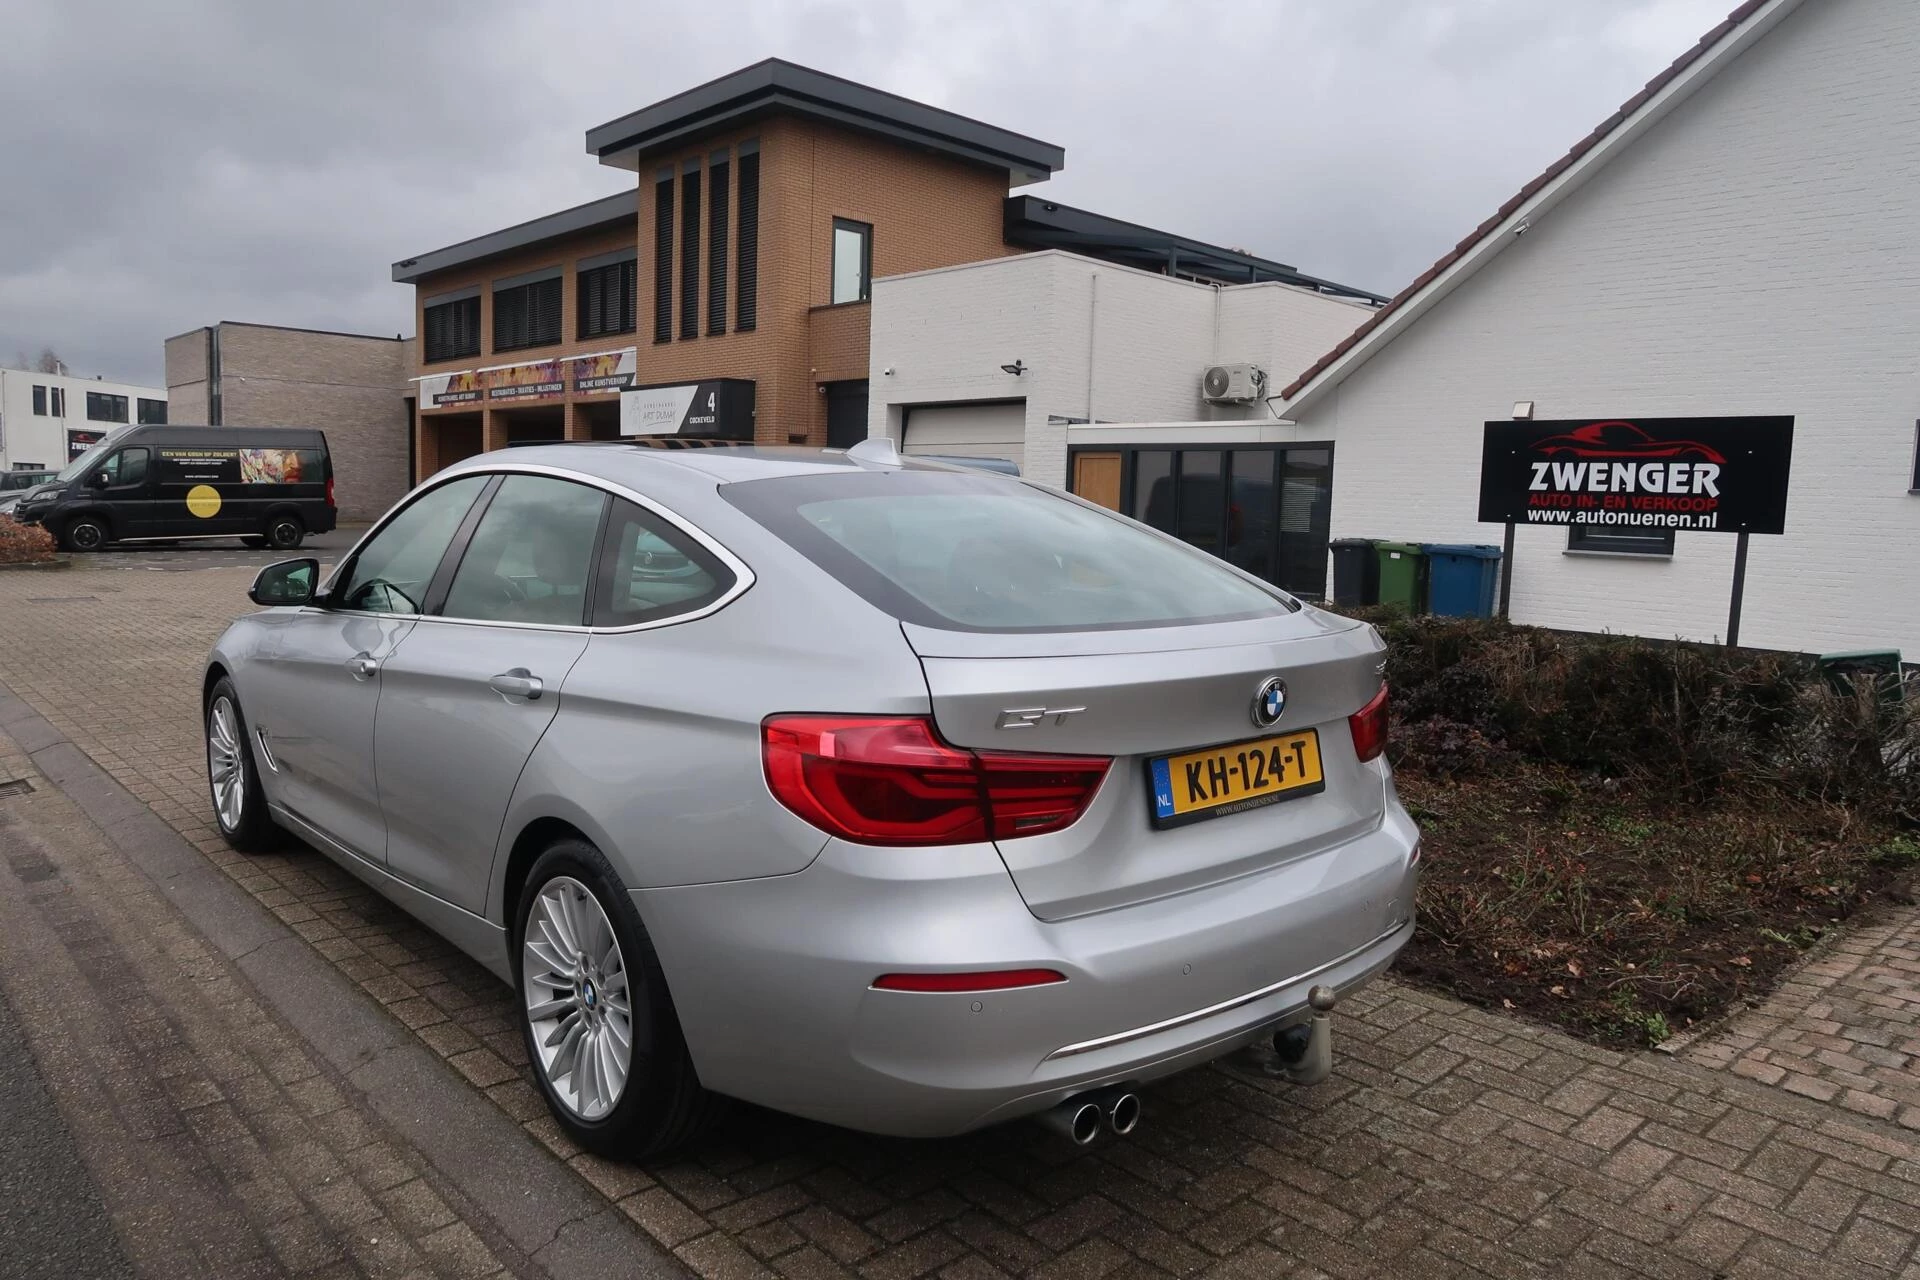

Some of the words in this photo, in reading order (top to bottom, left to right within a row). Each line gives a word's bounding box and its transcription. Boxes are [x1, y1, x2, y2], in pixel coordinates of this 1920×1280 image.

[707, 391, 716, 413] 4
[689, 415, 716, 425] COCKEVELD
[1529, 462, 1720, 498] ZWENGER
[1529, 494, 1572, 508] AUTO
[1577, 495, 1599, 508] IN-
[1604, 495, 1627, 510] EN
[1632, 496, 1719, 512] VERKOOP
[1527, 509, 1718, 528] www.autonuenen.nl
[995, 706, 1087, 729] GT
[1185, 740, 1306, 803] KH-124-T
[1158, 795, 1171, 807] NL
